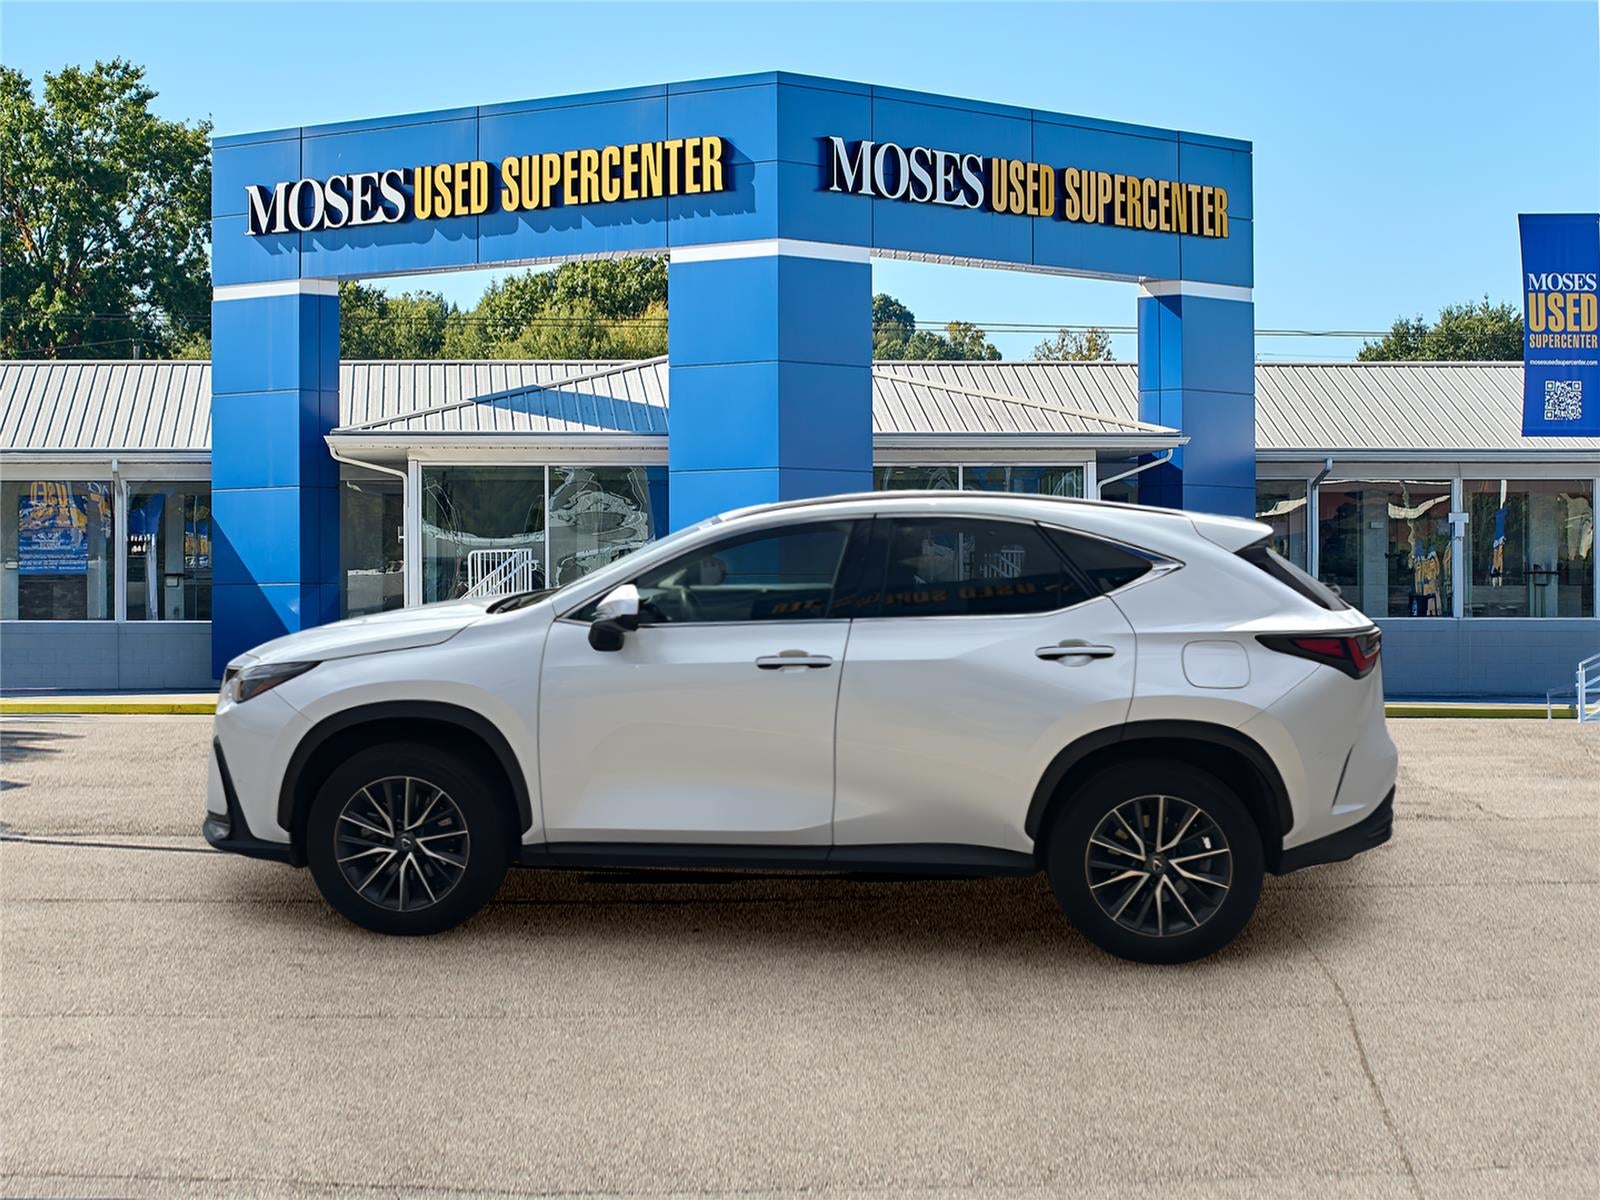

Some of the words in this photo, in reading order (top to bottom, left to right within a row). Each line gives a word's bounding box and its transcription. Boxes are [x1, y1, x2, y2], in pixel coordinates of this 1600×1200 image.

[244, 169, 406, 236] MOSES
[413, 161, 488, 220] USED
[501, 136, 723, 211] SUPERCENTER
[827, 136, 984, 209] MOSES
[991, 158, 1054, 217] USED
[1065, 167, 1229, 238] SUPERCENTER
[1528, 273, 1597, 291] MOSES
[1528, 292, 1598, 332] USED
[1529, 334, 1598, 348] SUPERCENTER
